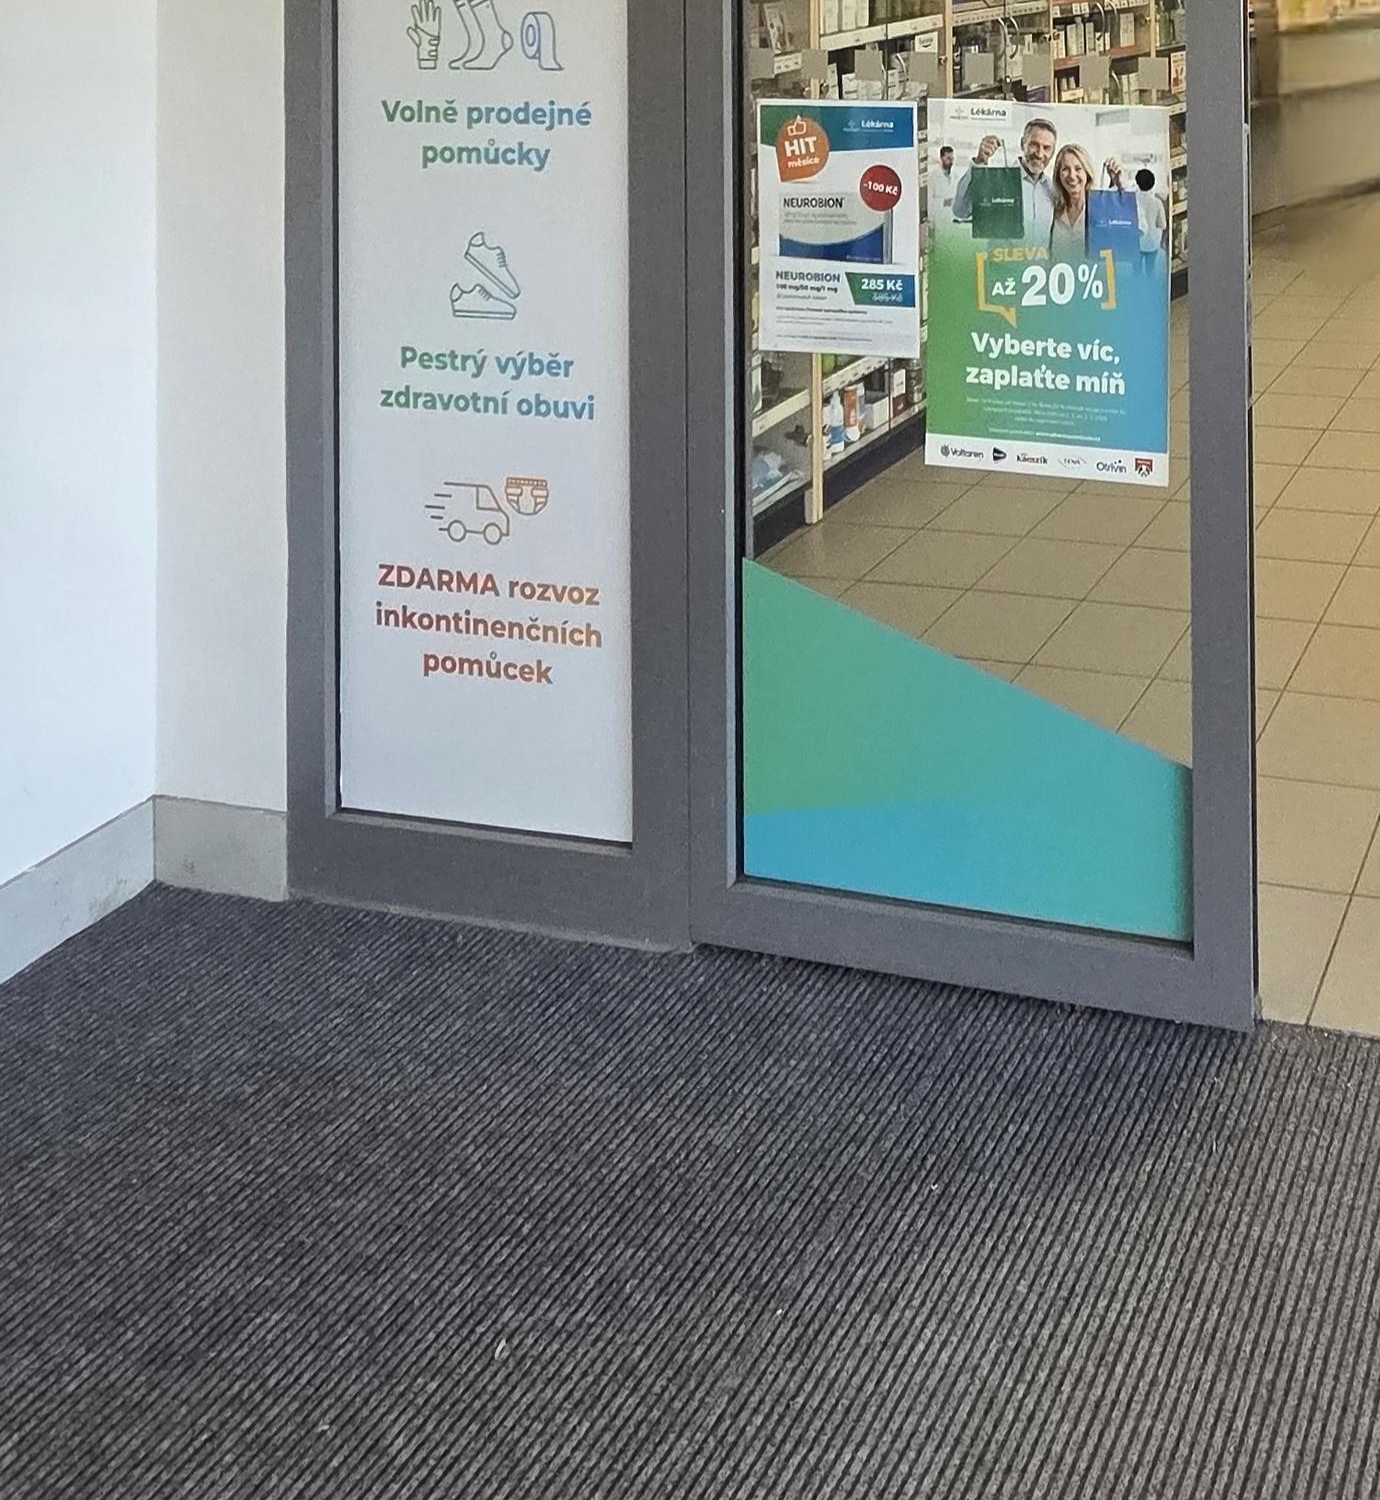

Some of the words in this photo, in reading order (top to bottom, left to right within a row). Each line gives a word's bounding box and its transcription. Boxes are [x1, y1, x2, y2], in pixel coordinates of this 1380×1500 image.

[381, 100, 458, 124] Volně
[466, 100, 592, 132] prodejné
[421, 140, 550, 172] pomůcky
[784, 136, 817, 157] HIT
[787, 156, 821, 169] měsíce
[783, 197, 843, 209] NEUROBION
[885, 185, 899, 196] Kč
[992, 246, 1048, 261] SLEVA
[775, 271, 841, 283] NEUROBION
[861, 278, 884, 290] 285
[887, 278, 903, 291] Kč
[992, 277, 1017, 296] AŽ
[1021, 263, 1103, 306] 20%
[970, 332, 1072, 359] Vyberte
[1077, 338, 1120, 364] víc,
[400, 346, 487, 380] Pestrý
[495, 350, 574, 382] výběr
[966, 364, 1070, 390] zaplaťte
[1076, 371, 1125, 395] míň
[380, 386, 509, 417] zdravotní
[516, 393, 596, 421] obuvi
[950, 447, 984, 460] Voltaren
[378, 564, 500, 598] ZDARMA
[508, 579, 600, 606] rozvoz
[375, 601, 602, 649] inkontinenčních
[422, 653, 553, 685] pomůcek
